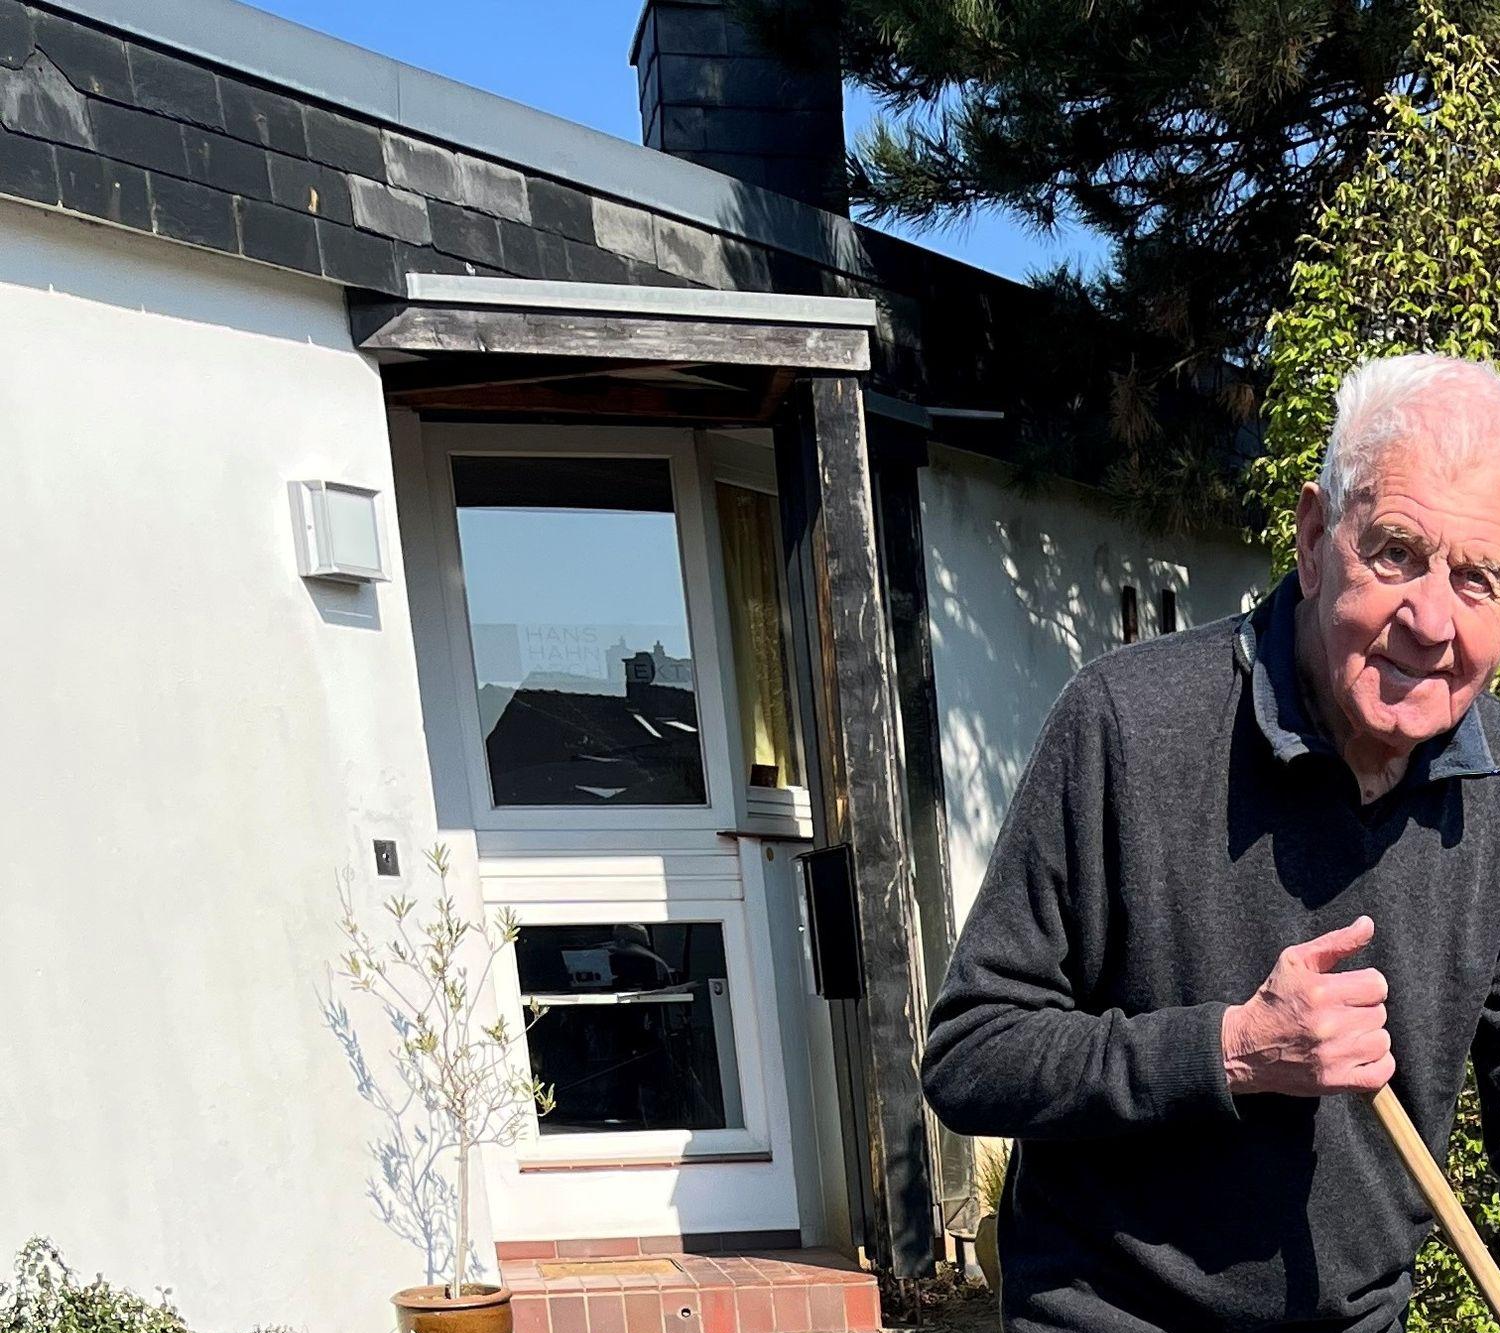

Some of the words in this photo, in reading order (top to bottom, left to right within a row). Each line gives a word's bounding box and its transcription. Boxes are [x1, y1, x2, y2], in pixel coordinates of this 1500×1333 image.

[526, 626, 598, 643] HANS
[528, 645, 600, 661] HAHN
[531, 662, 684, 680] ARCHEKT
